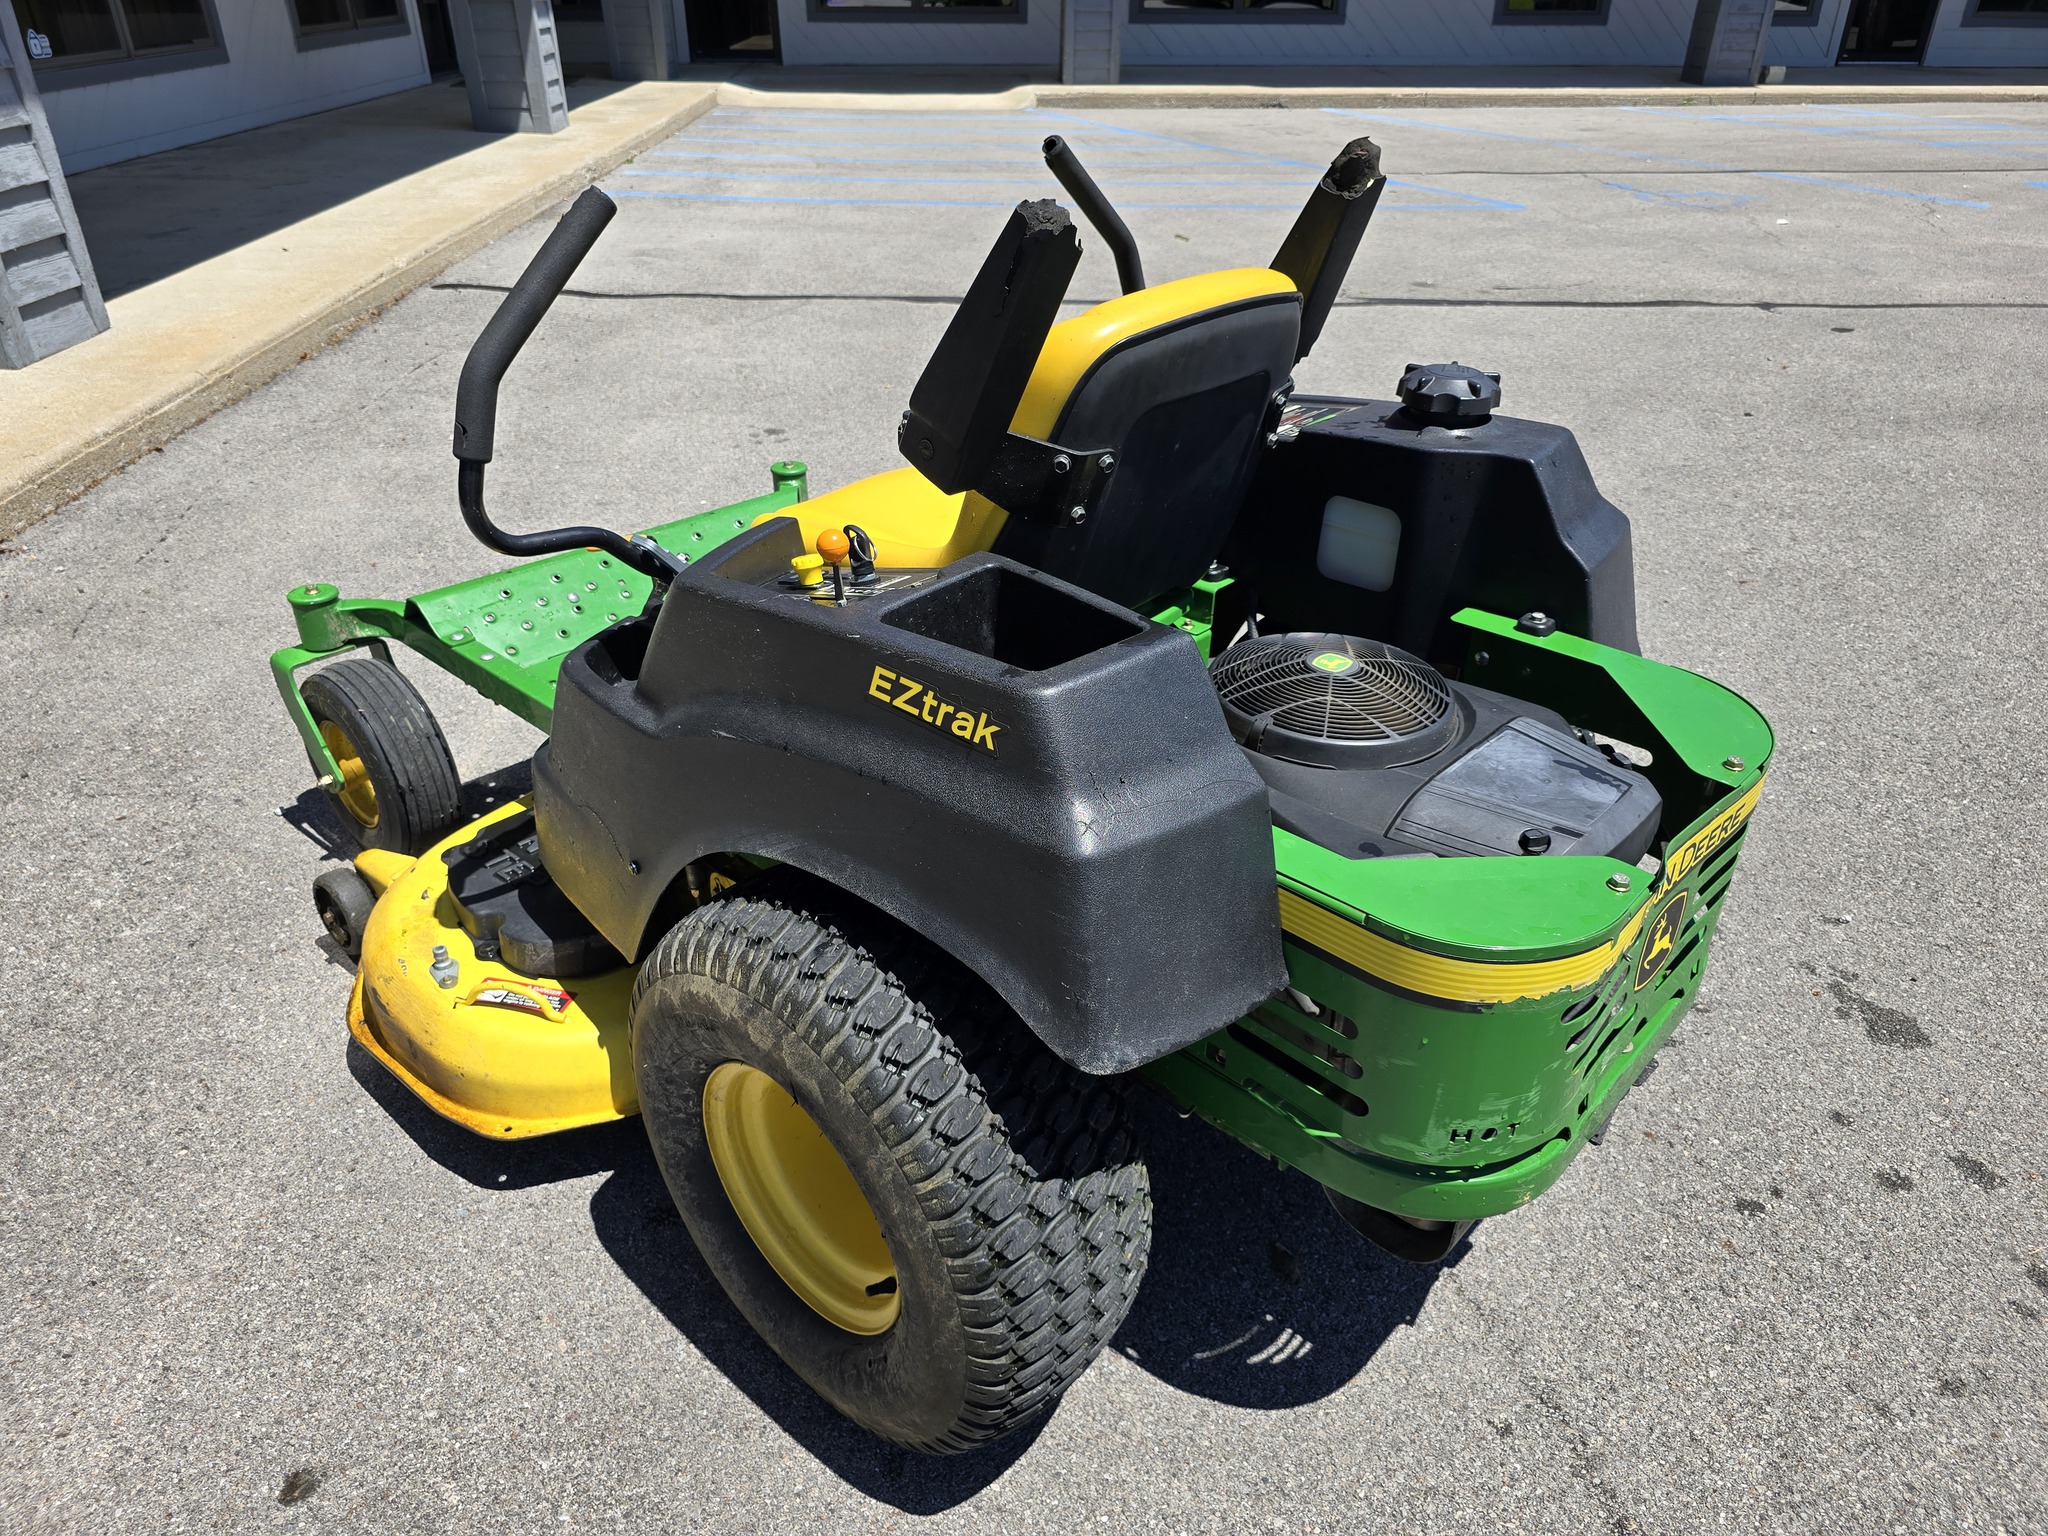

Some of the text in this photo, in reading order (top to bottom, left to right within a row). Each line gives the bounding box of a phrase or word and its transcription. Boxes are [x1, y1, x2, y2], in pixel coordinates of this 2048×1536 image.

[869, 666, 1001, 751] EZtrak
[1679, 803, 1747, 876] DEERE
[1450, 1122, 1520, 1143] HOT
